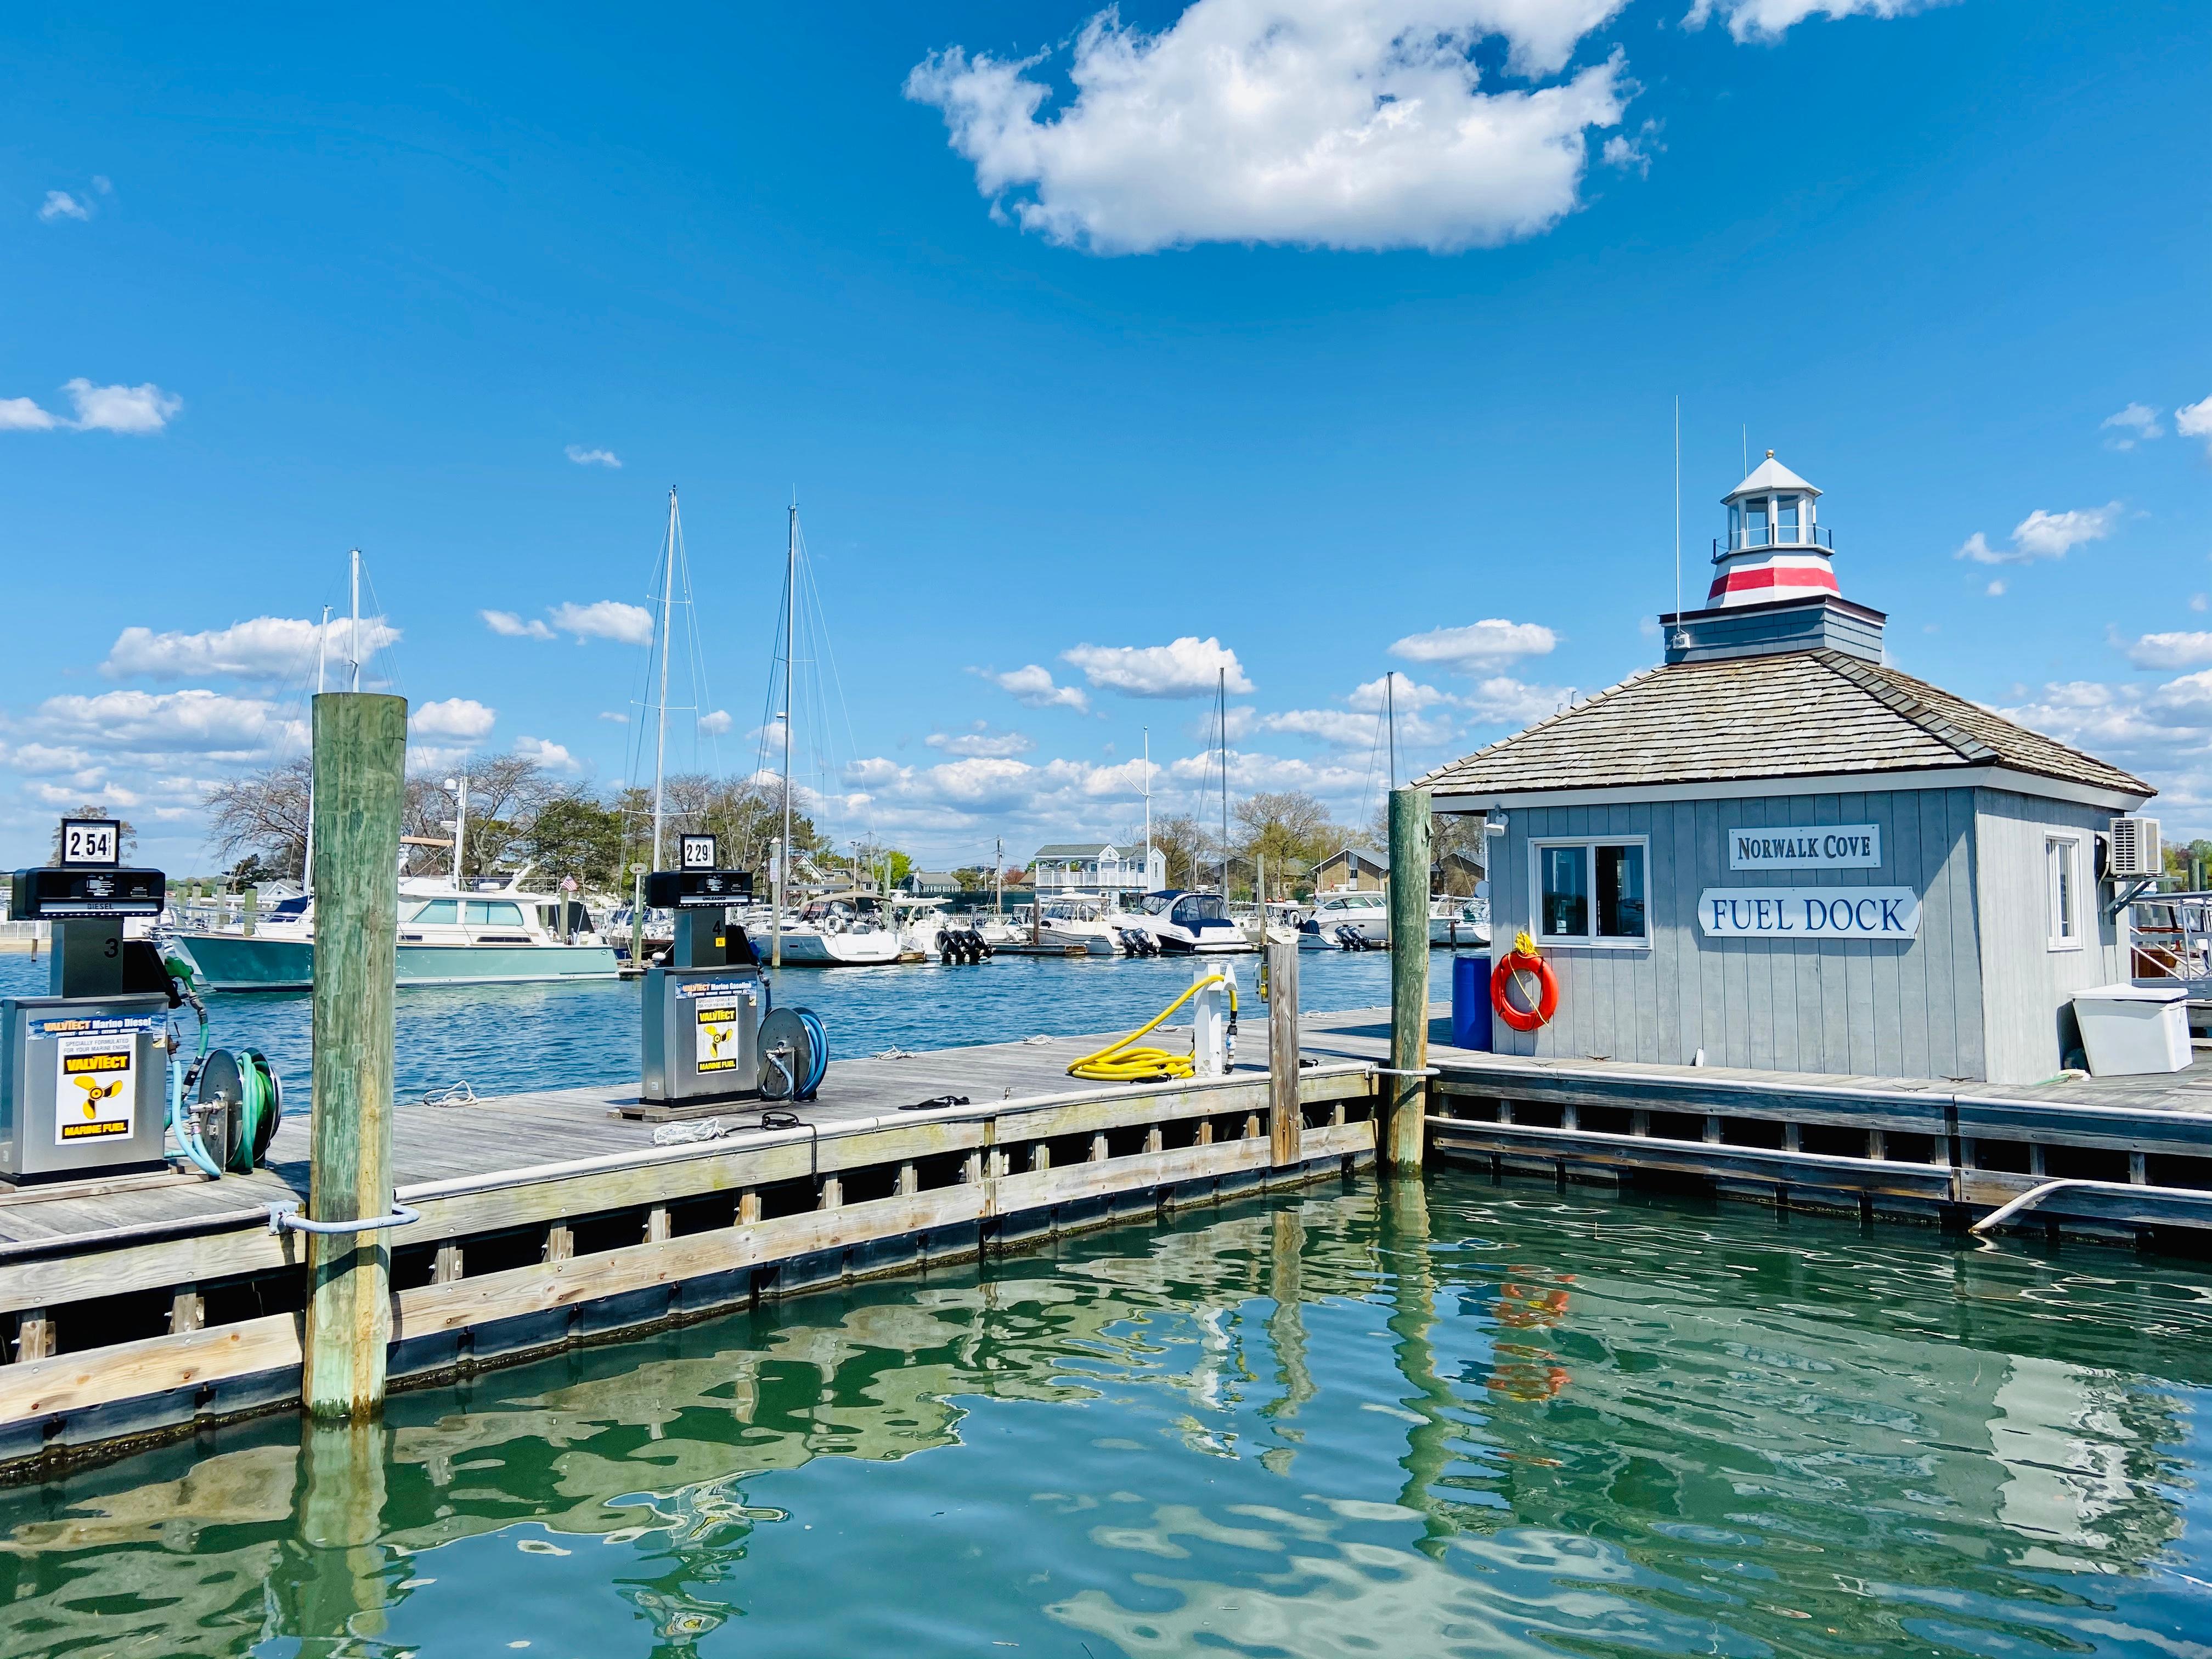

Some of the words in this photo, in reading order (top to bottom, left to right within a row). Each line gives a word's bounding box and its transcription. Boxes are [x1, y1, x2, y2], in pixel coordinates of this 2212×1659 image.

[1737, 837, 1819, 860] NORWALK
[1823, 834, 1870, 859] COVE
[1711, 899, 1793, 930] FUEL
[1803, 899, 1906, 932] DOCK
[712, 920, 722, 935] 4
[104, 938, 119, 958] 3
[729, 981, 752, 990] Gasoline
[699, 1009, 735, 1022] VALVTECT
[92, 1019, 123, 1029] Marine
[124, 1017, 151, 1028] Diesel
[66, 1055, 128, 1071] VALVTECT
[699, 1061, 721, 1070] MARINE
[721, 1060, 736, 1068] FUEL
[64, 1124, 102, 1136] MARINE
[102, 1122, 127, 1133] FUEL
